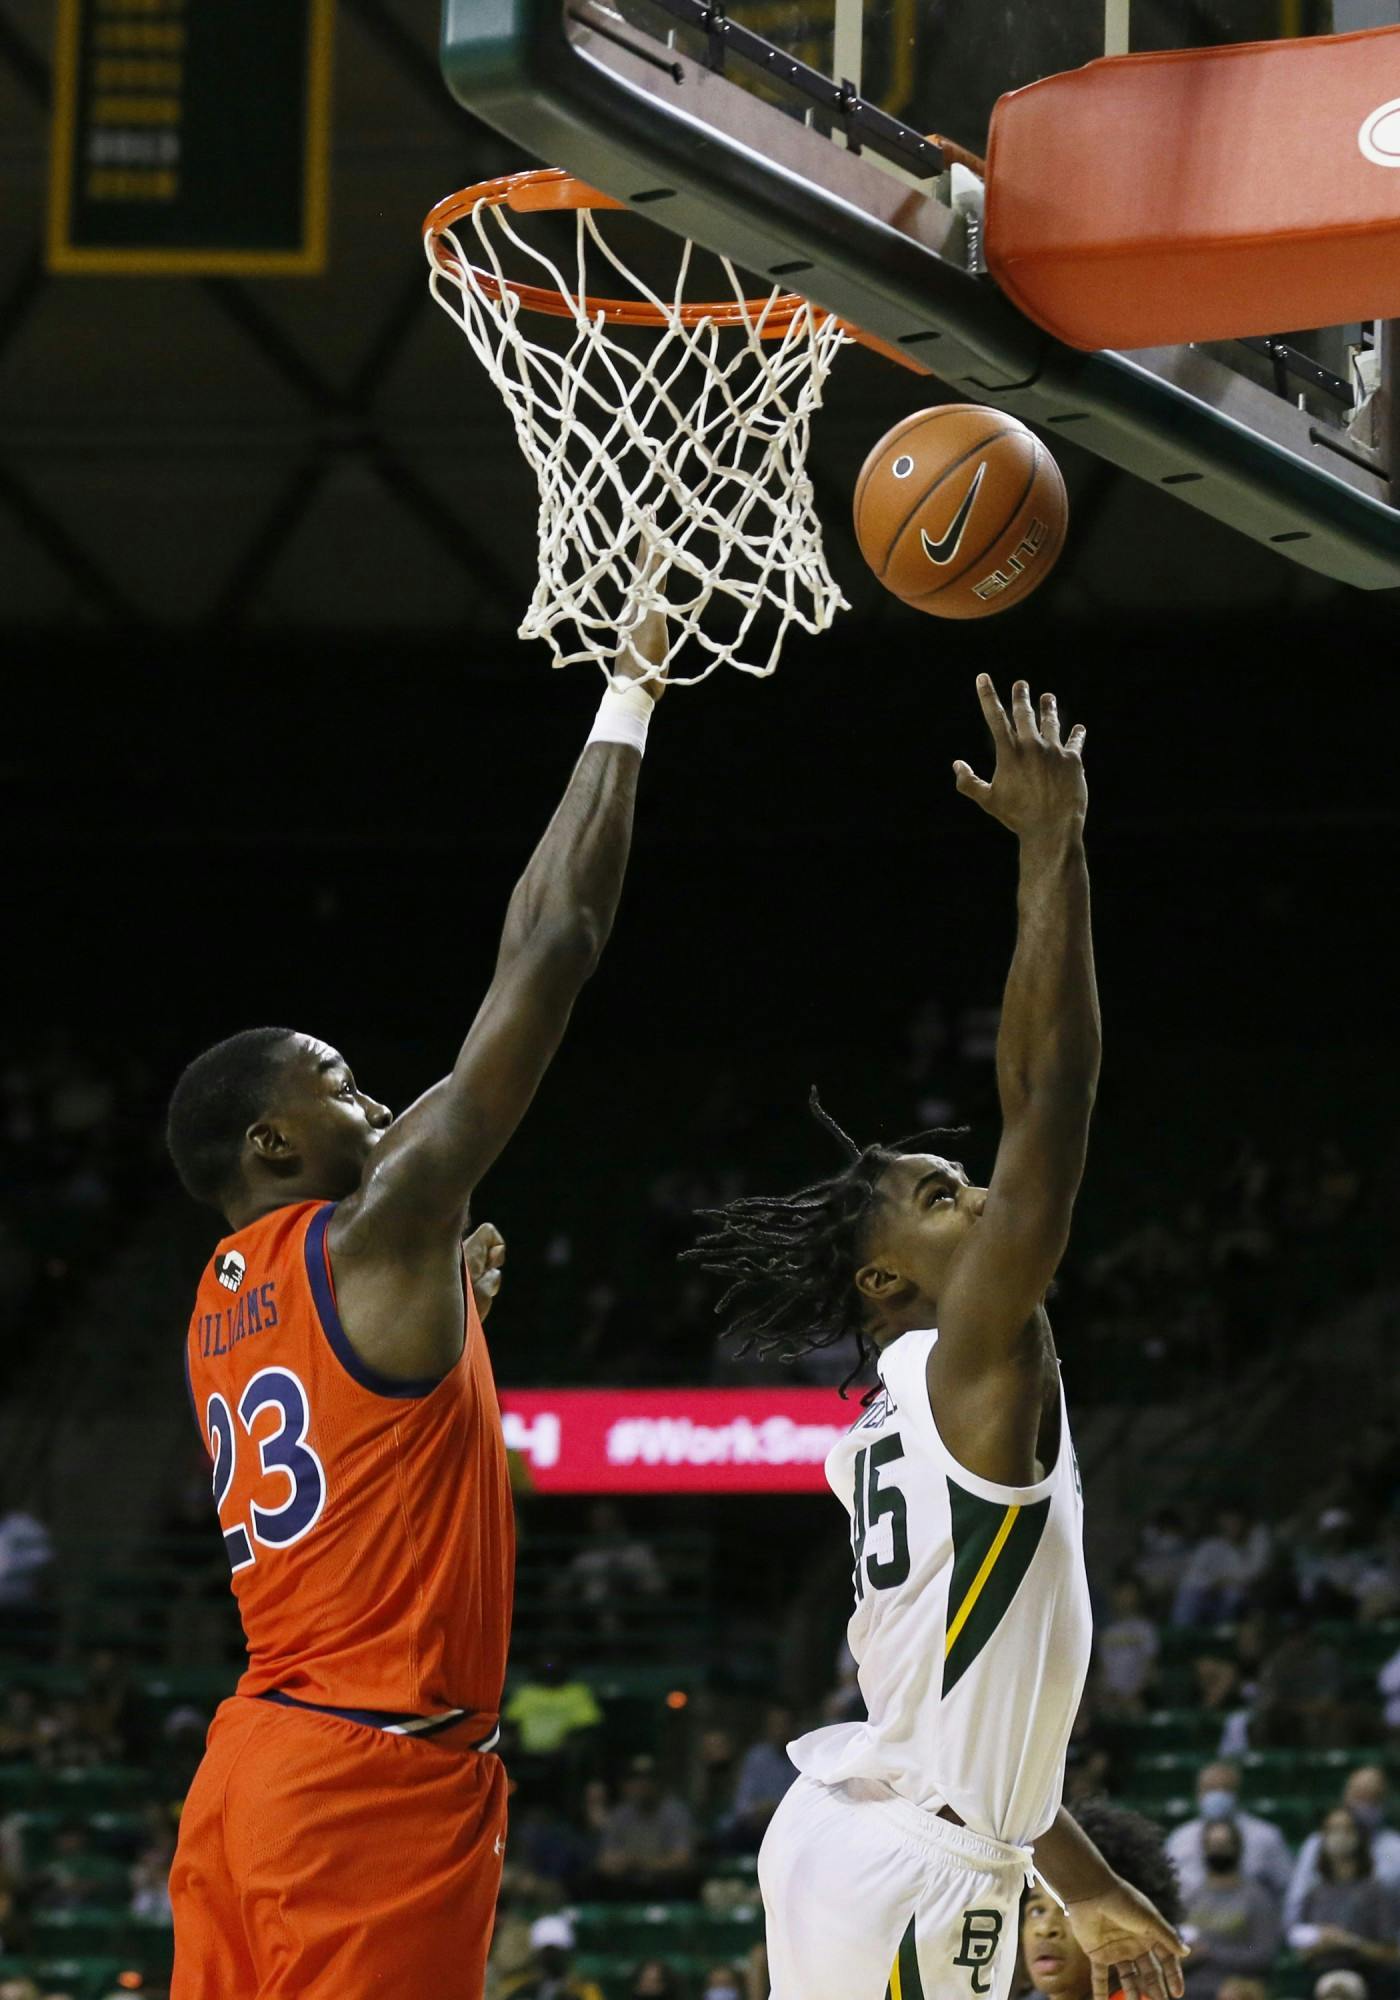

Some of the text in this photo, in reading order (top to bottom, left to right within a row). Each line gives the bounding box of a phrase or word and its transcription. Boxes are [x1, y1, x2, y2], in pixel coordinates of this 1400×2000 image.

[971, 517, 1049, 600] ELITE
[199, 1281, 279, 1358] ILAMS
[206, 1366, 327, 1573] 23
[607, 1415, 858, 1466] #WorkSm
